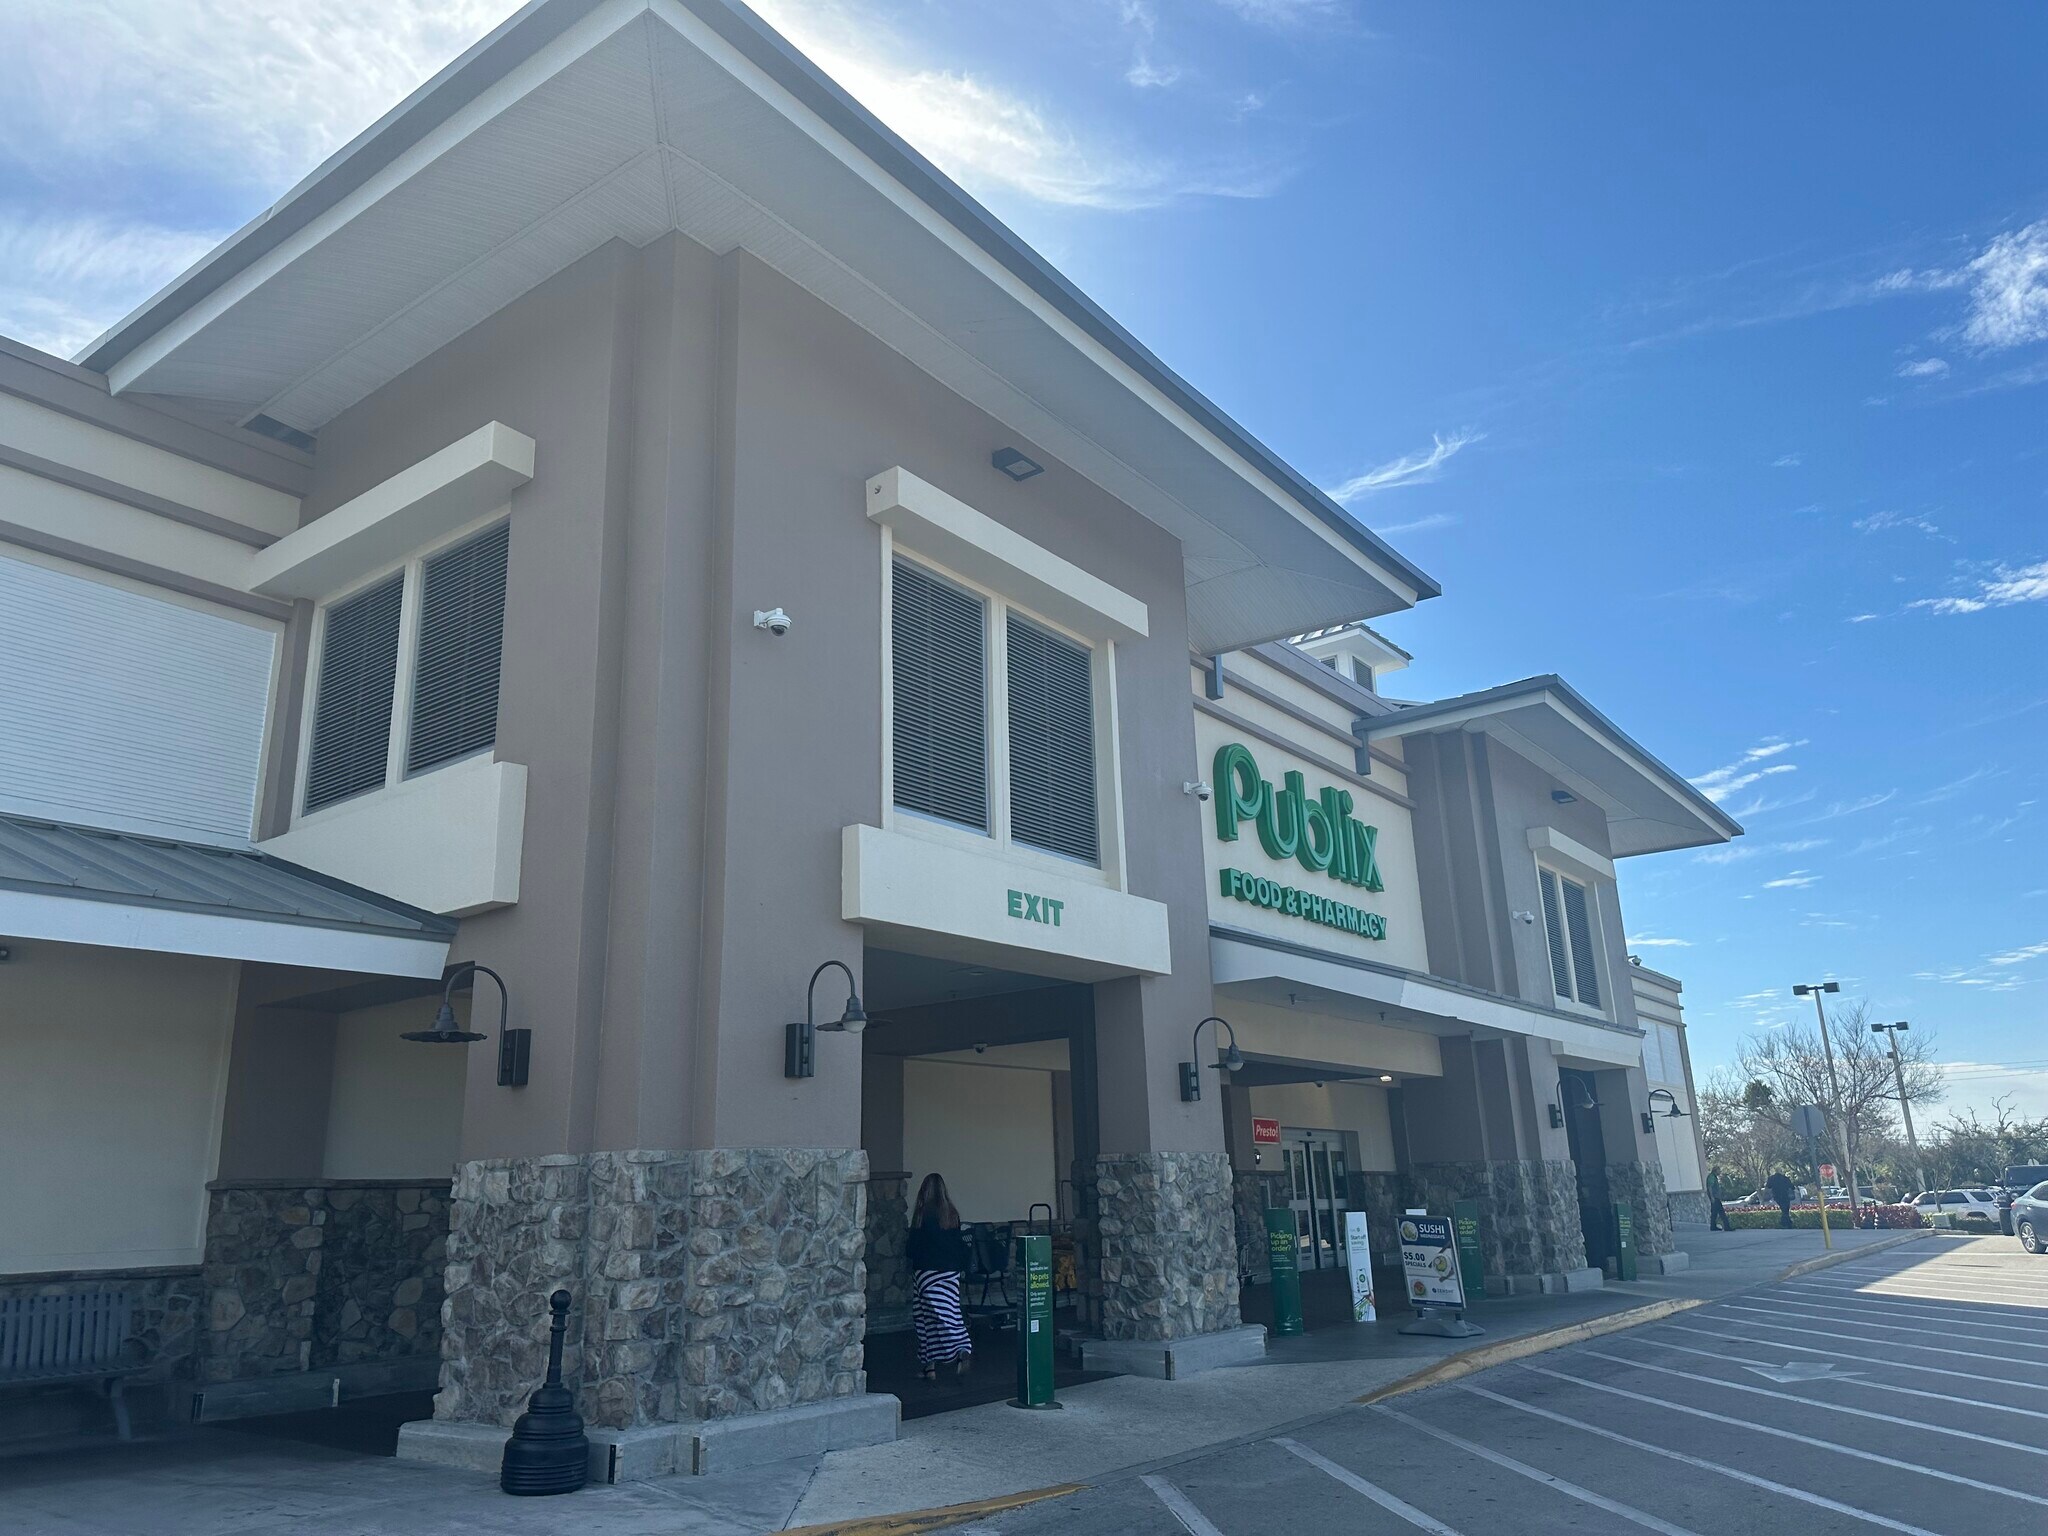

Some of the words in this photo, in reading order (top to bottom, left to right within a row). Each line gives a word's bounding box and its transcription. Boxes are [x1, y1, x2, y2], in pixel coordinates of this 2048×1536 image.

[1213, 743, 1384, 892] Publix
[1007, 889, 1064, 927] EXIT
[1219, 867, 1283, 909] FOOD
[1297, 890, 1387, 940] PHARMACY
[1256, 1124, 1279, 1137] Presto!
[1418, 1223, 1445, 1234] SUSHI
[1270, 1232, 1293, 1240] Picking
[1403, 1251, 1425, 1261] $5.00
[1030, 1273, 1038, 1281] No
[1038, 1273, 1049, 1282] pets
